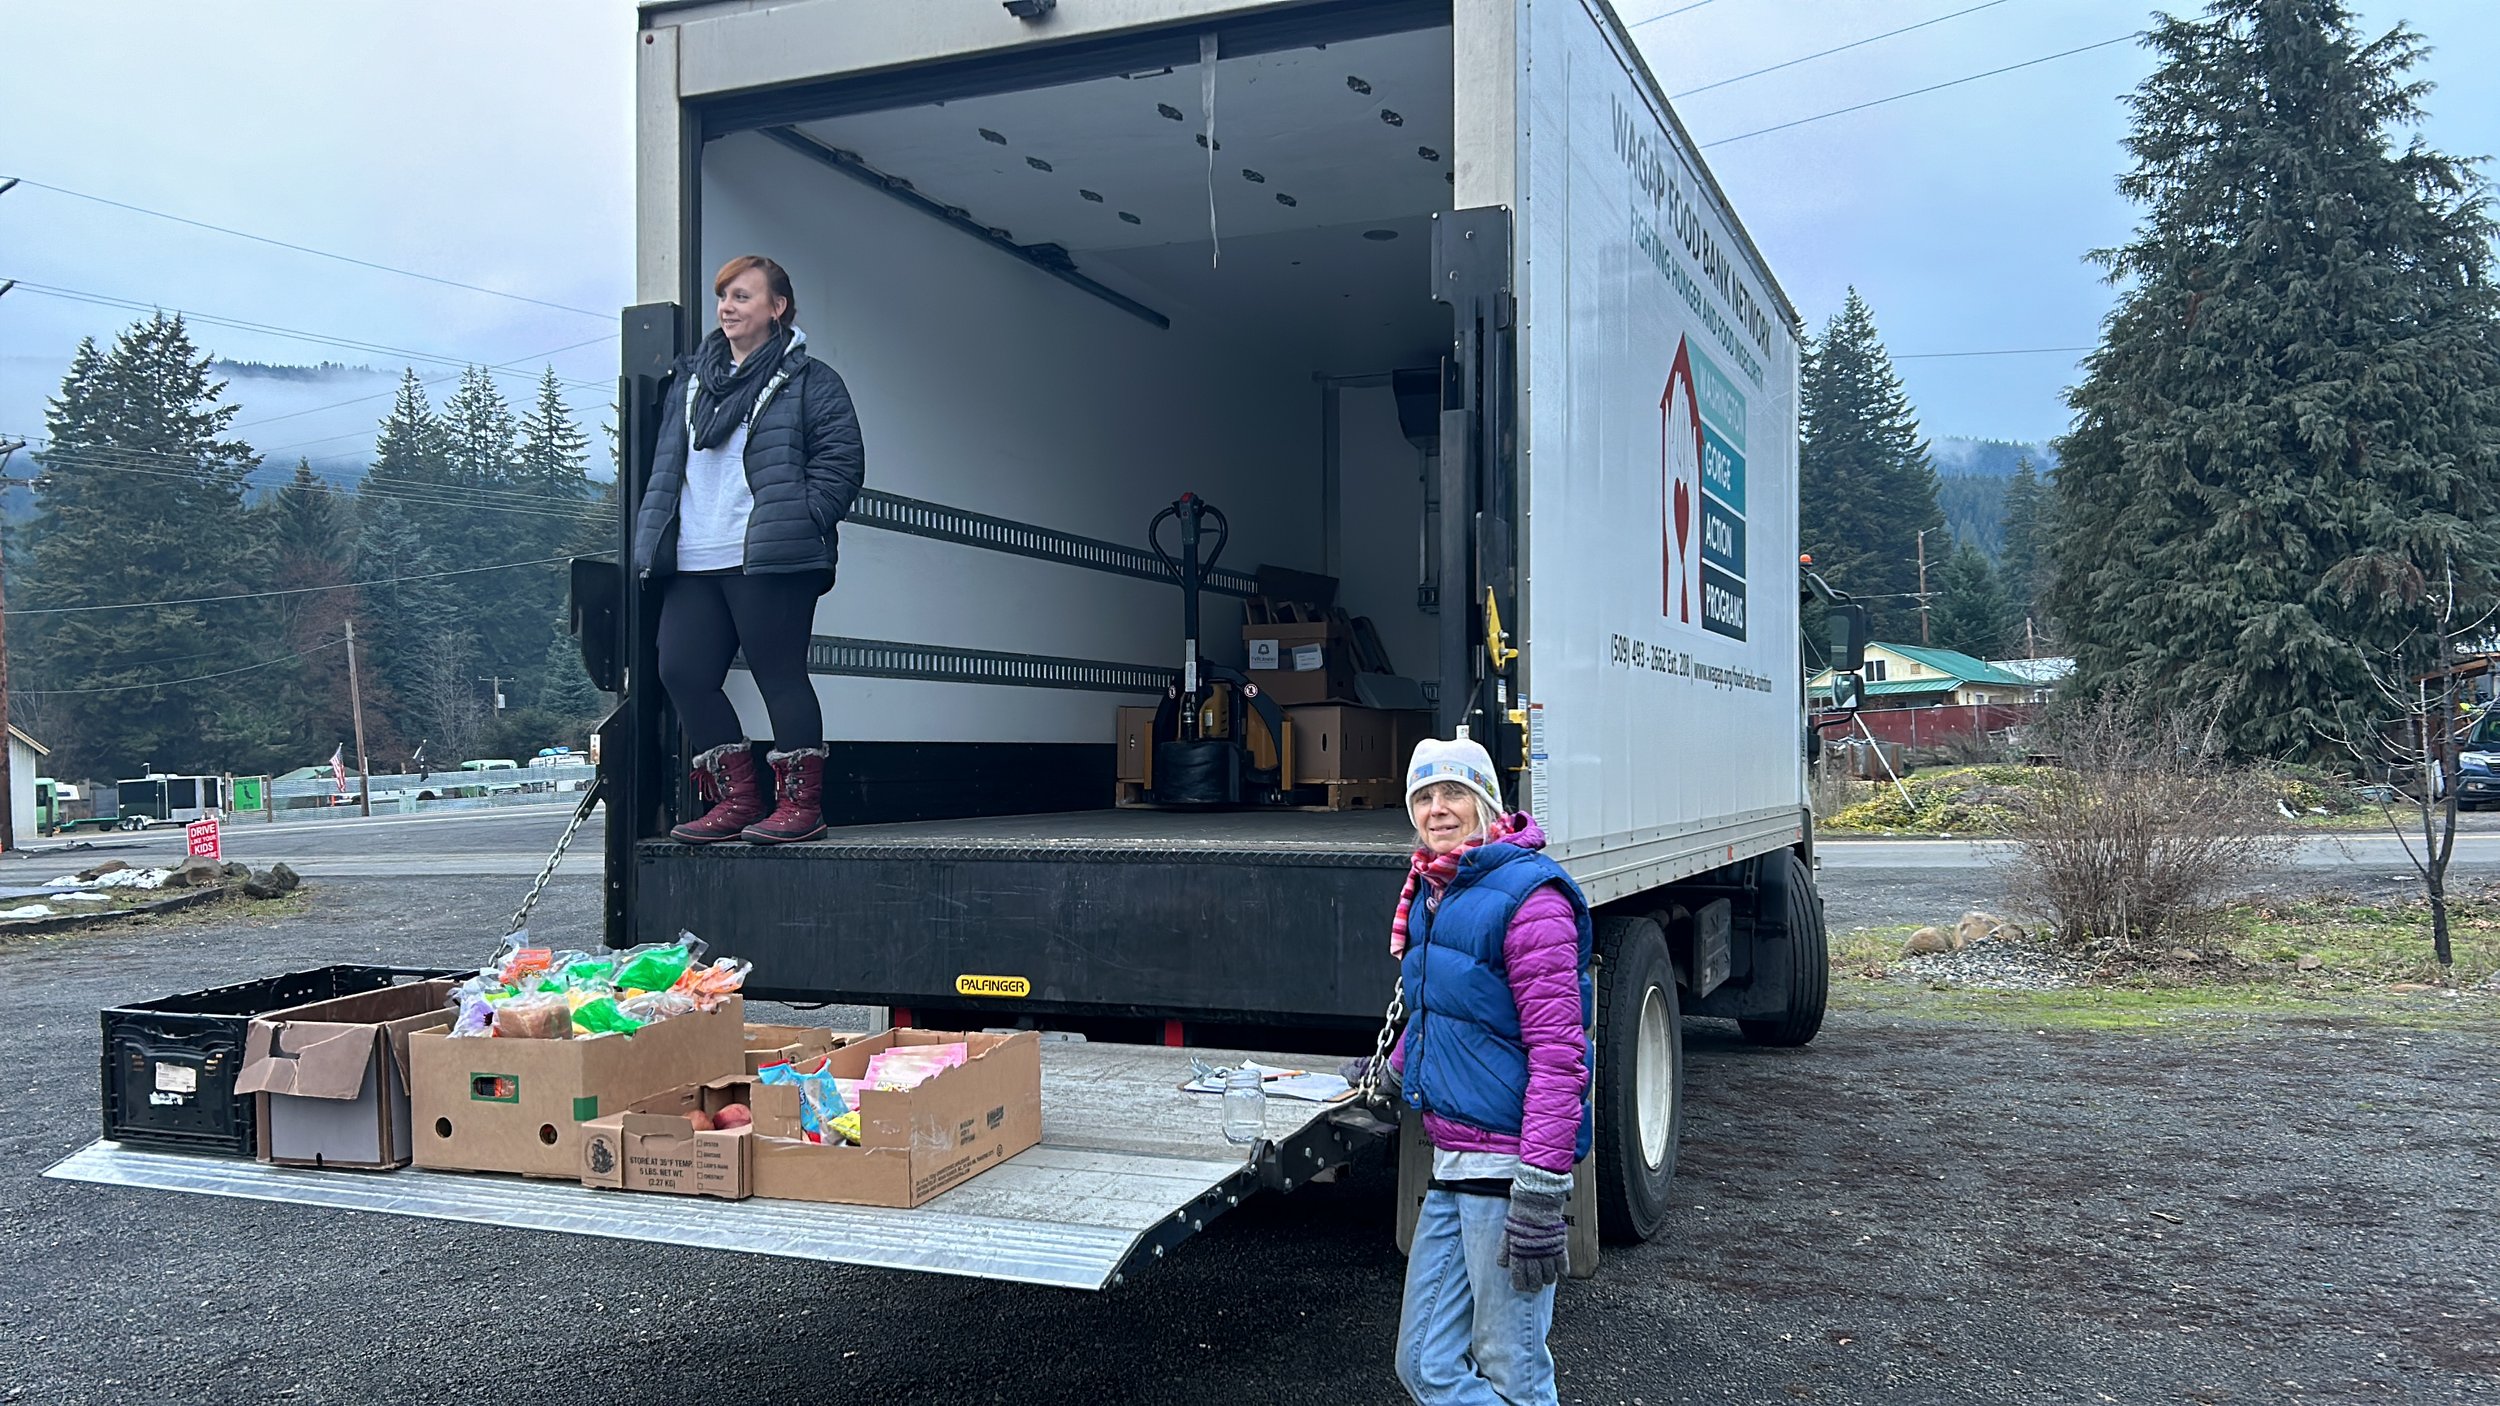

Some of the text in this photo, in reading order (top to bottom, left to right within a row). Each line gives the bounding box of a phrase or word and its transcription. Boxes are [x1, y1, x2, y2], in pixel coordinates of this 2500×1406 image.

[1611, 92, 1771, 363] WAGAP FOOD BANK NETWORK
[1630, 204, 1764, 392] FIGHTING HUNGER AND FOOD INSECURITY
[1705, 441, 1731, 491] GORGE
[1705, 512, 1733, 558] ACTION
[1706, 583, 1743, 629] PROGRAMS
[1610, 633, 1630, 670] (509)
[1631, 640, 1645, 668] 493
[1651, 645, 1667, 673] 2662
[191, 823, 215, 838] DRIVE
[195, 842, 213, 855] KIDS
[961, 979, 1025, 993] PALFINGER
[630, 1156, 650, 1165] STORE
